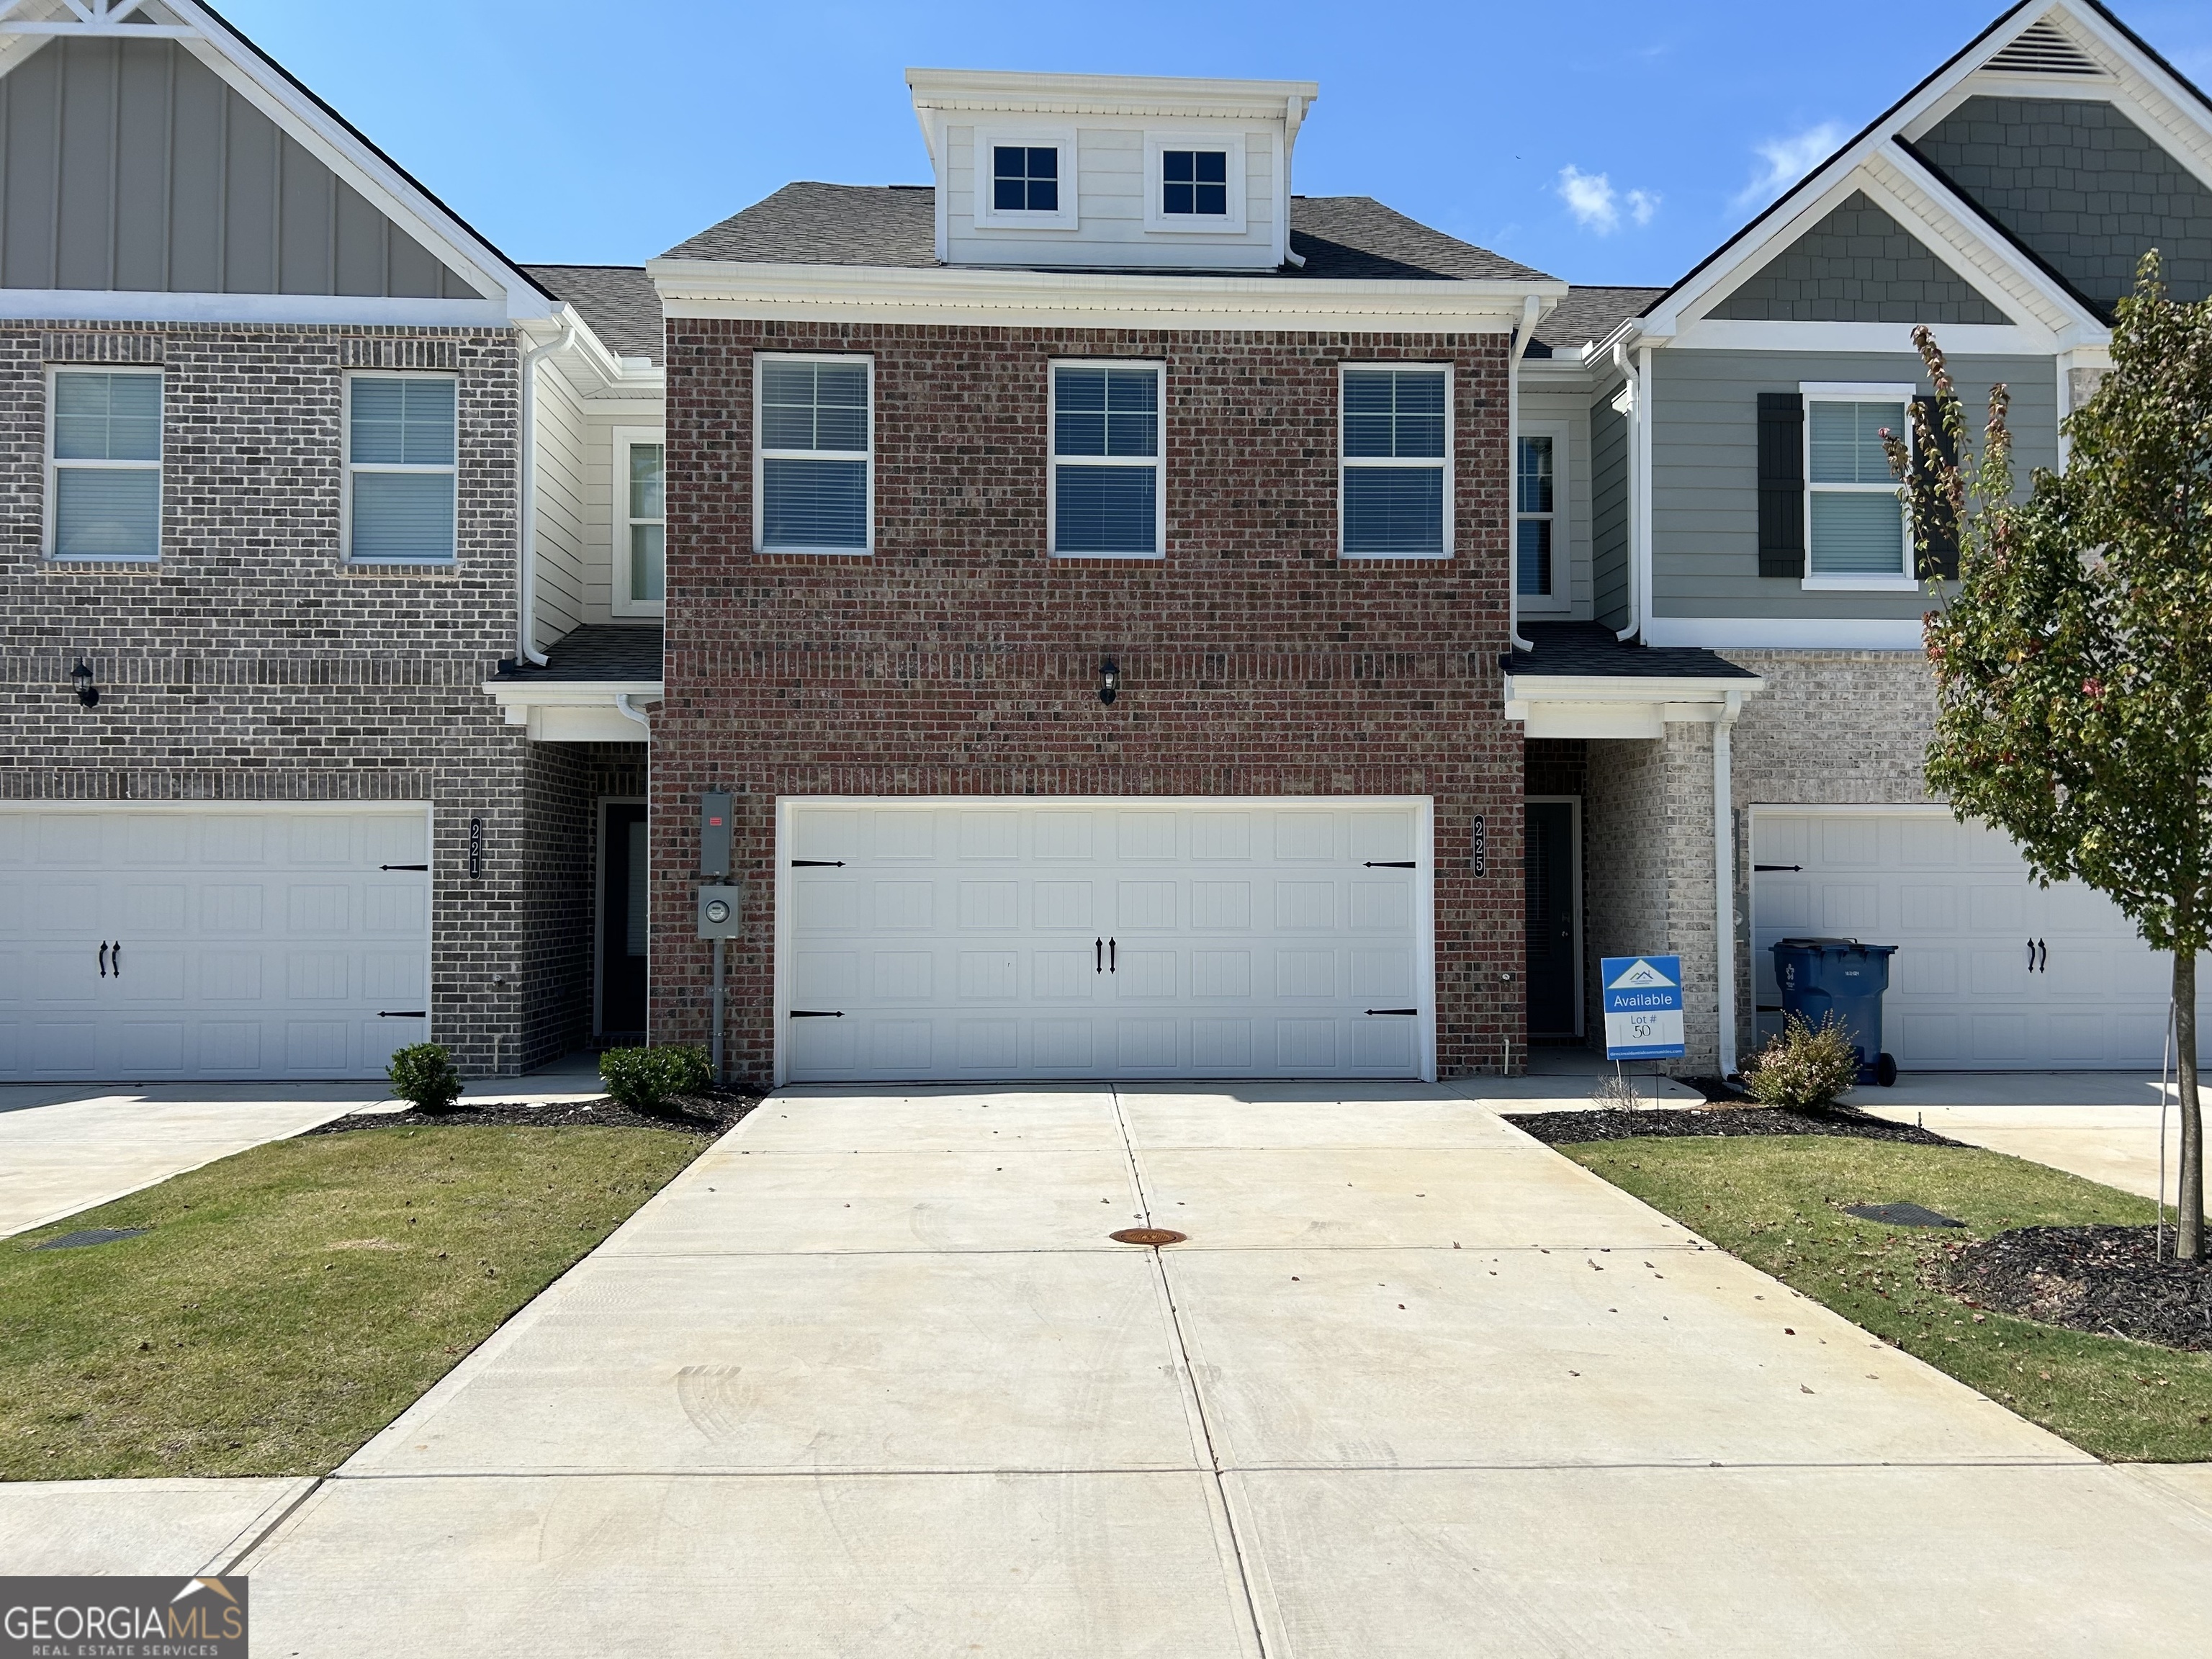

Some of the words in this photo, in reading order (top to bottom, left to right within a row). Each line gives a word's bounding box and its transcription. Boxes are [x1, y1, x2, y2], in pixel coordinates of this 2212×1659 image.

[1614, 993, 1673, 1007] Available
[1631, 1015, 1647, 1024] Lot
[1650, 1015, 1657, 1023] #
[1632, 1025, 1651, 1038] 50
